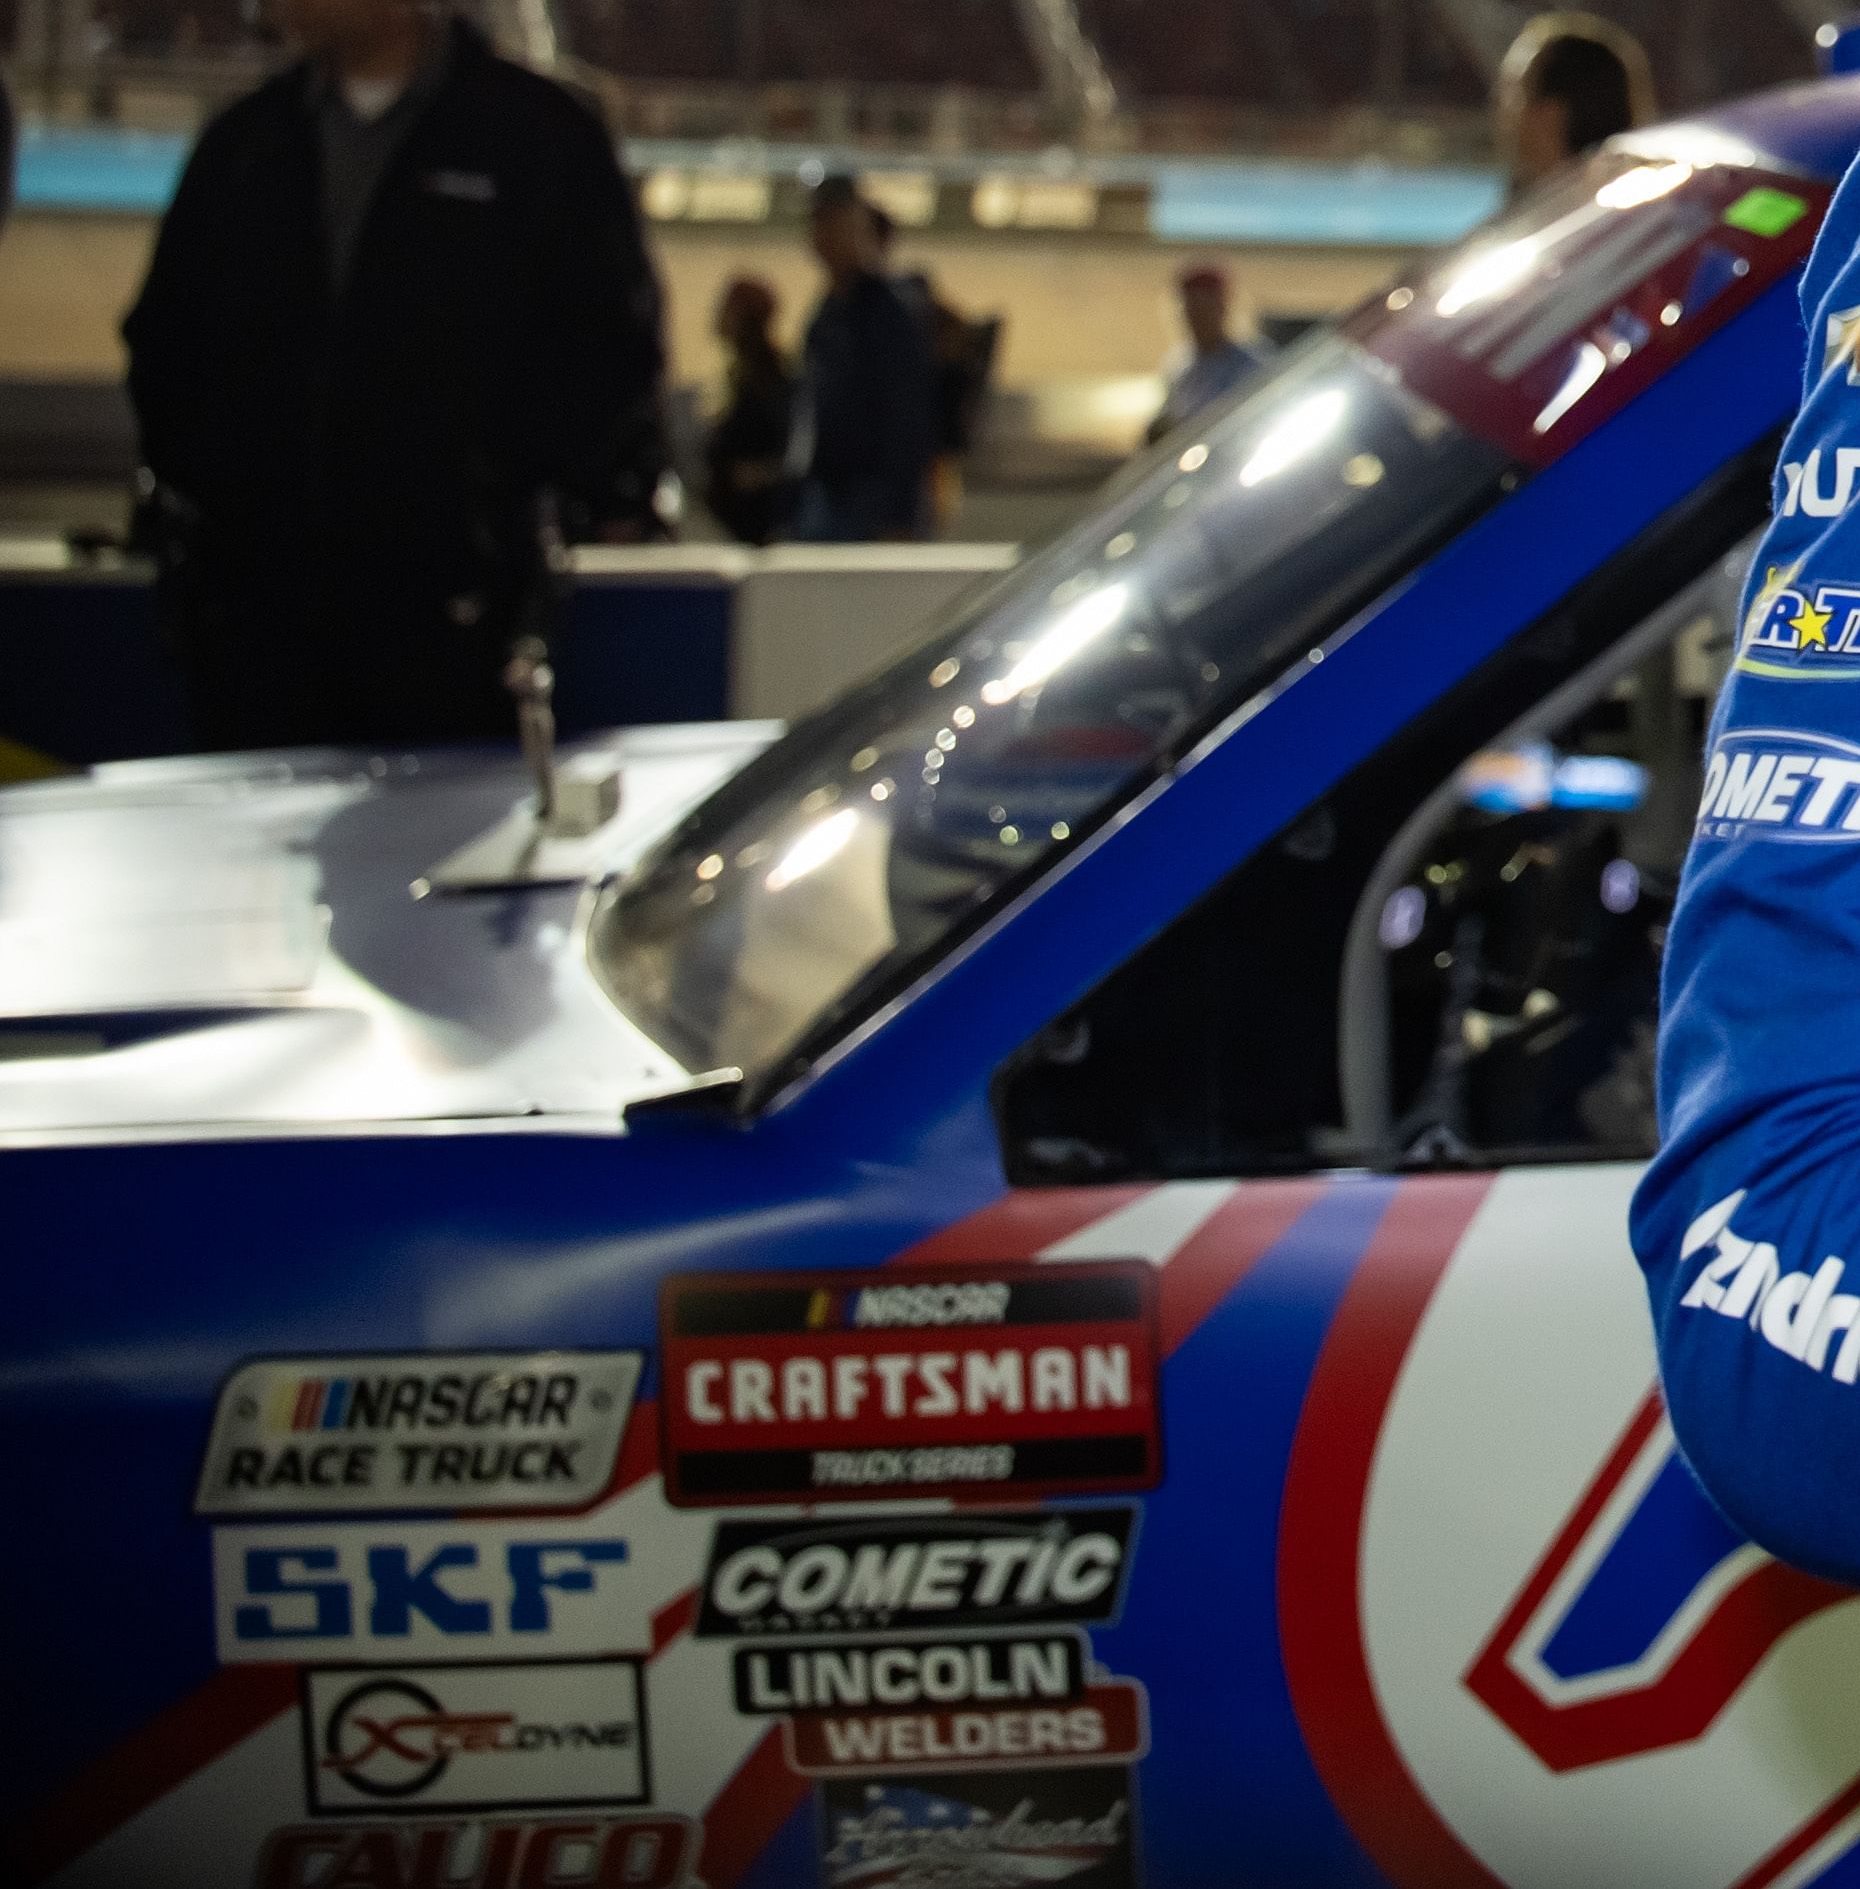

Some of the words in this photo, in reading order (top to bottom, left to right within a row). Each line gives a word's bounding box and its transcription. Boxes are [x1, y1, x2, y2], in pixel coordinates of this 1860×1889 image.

[347, 1373, 578, 1428] NASCAR
[686, 1345, 1131, 1424] CRAFTSMAN
[226, 1444, 377, 1489] RACE
[396, 1440, 580, 1485] TRUCK
[236, 1541, 629, 1640] SKF
[713, 1532, 1120, 1614] COMETIC
[748, 1641, 1068, 1708] LINCOLN
[822, 1710, 1105, 1760] WELDERS
